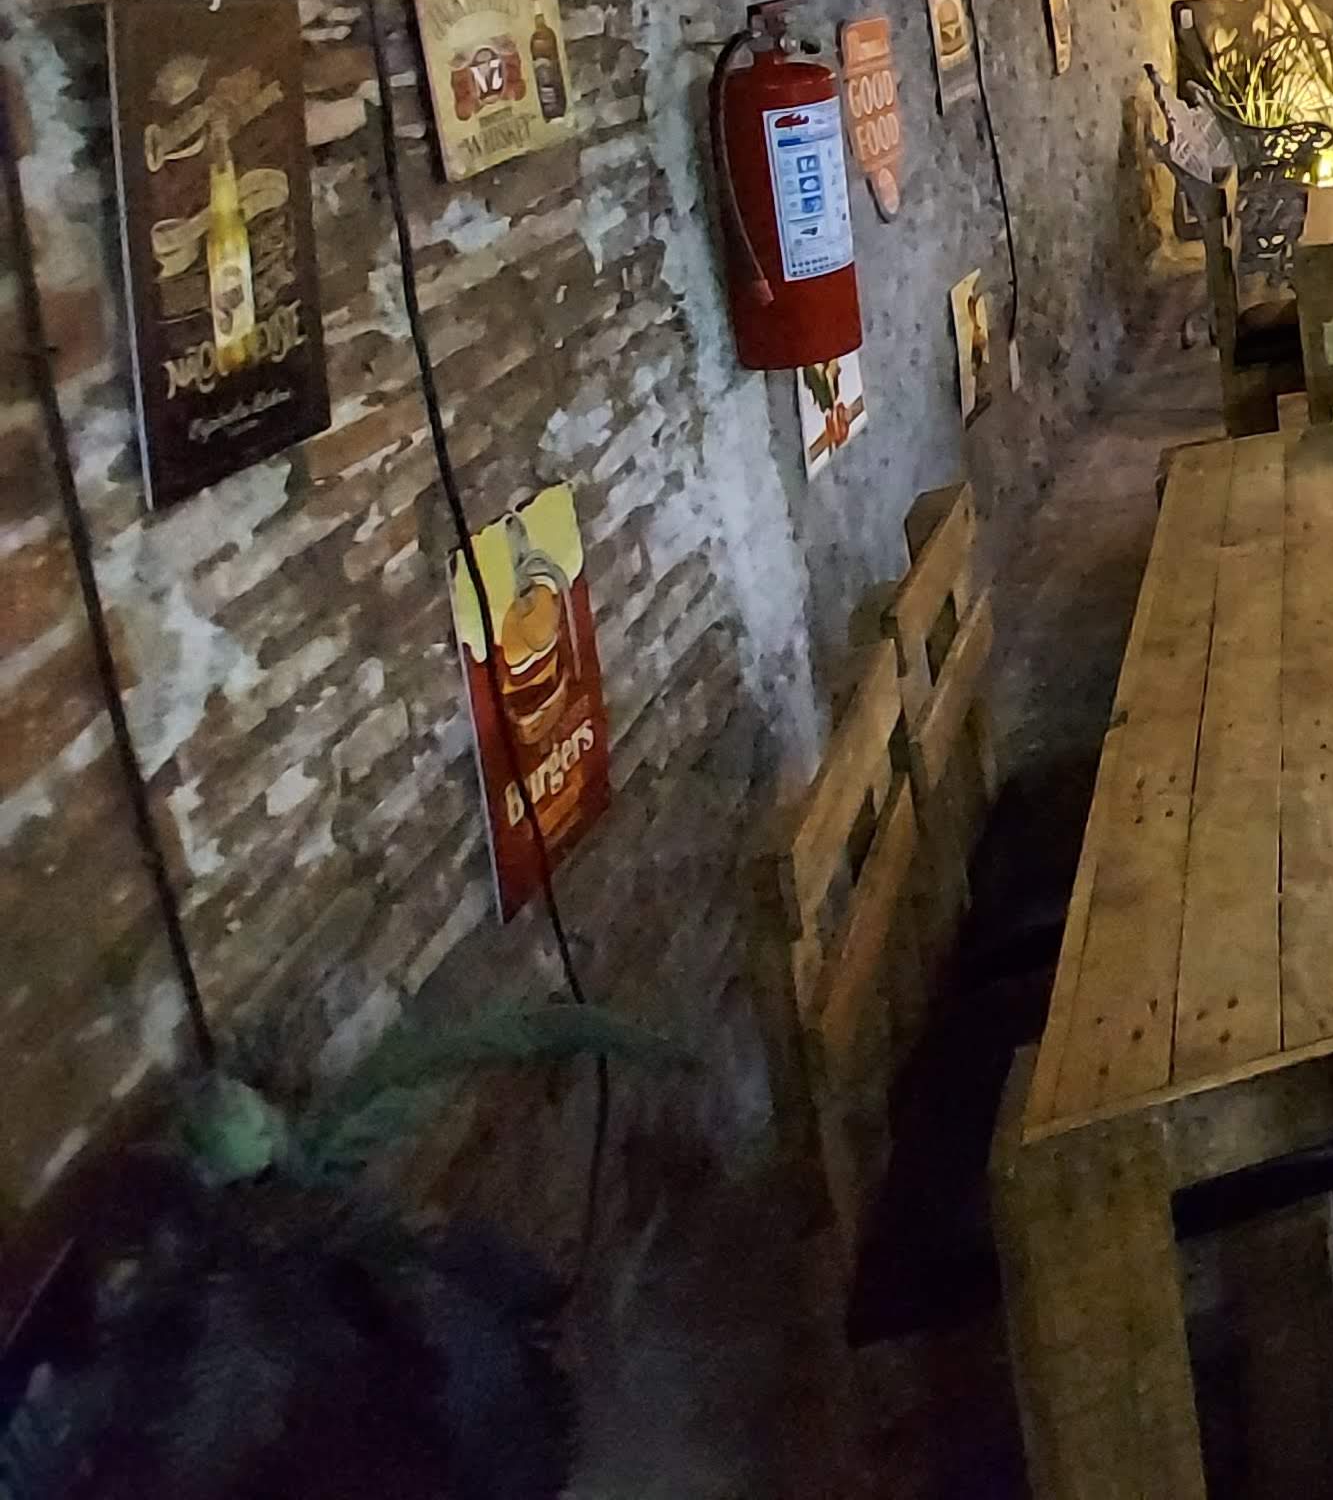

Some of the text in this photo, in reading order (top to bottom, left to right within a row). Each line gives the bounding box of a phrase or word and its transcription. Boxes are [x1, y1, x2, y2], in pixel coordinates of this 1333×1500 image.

[848, 70, 894, 119] GOOD
[856, 112, 900, 163] FOOD
[505, 718, 595, 828] Burgers
